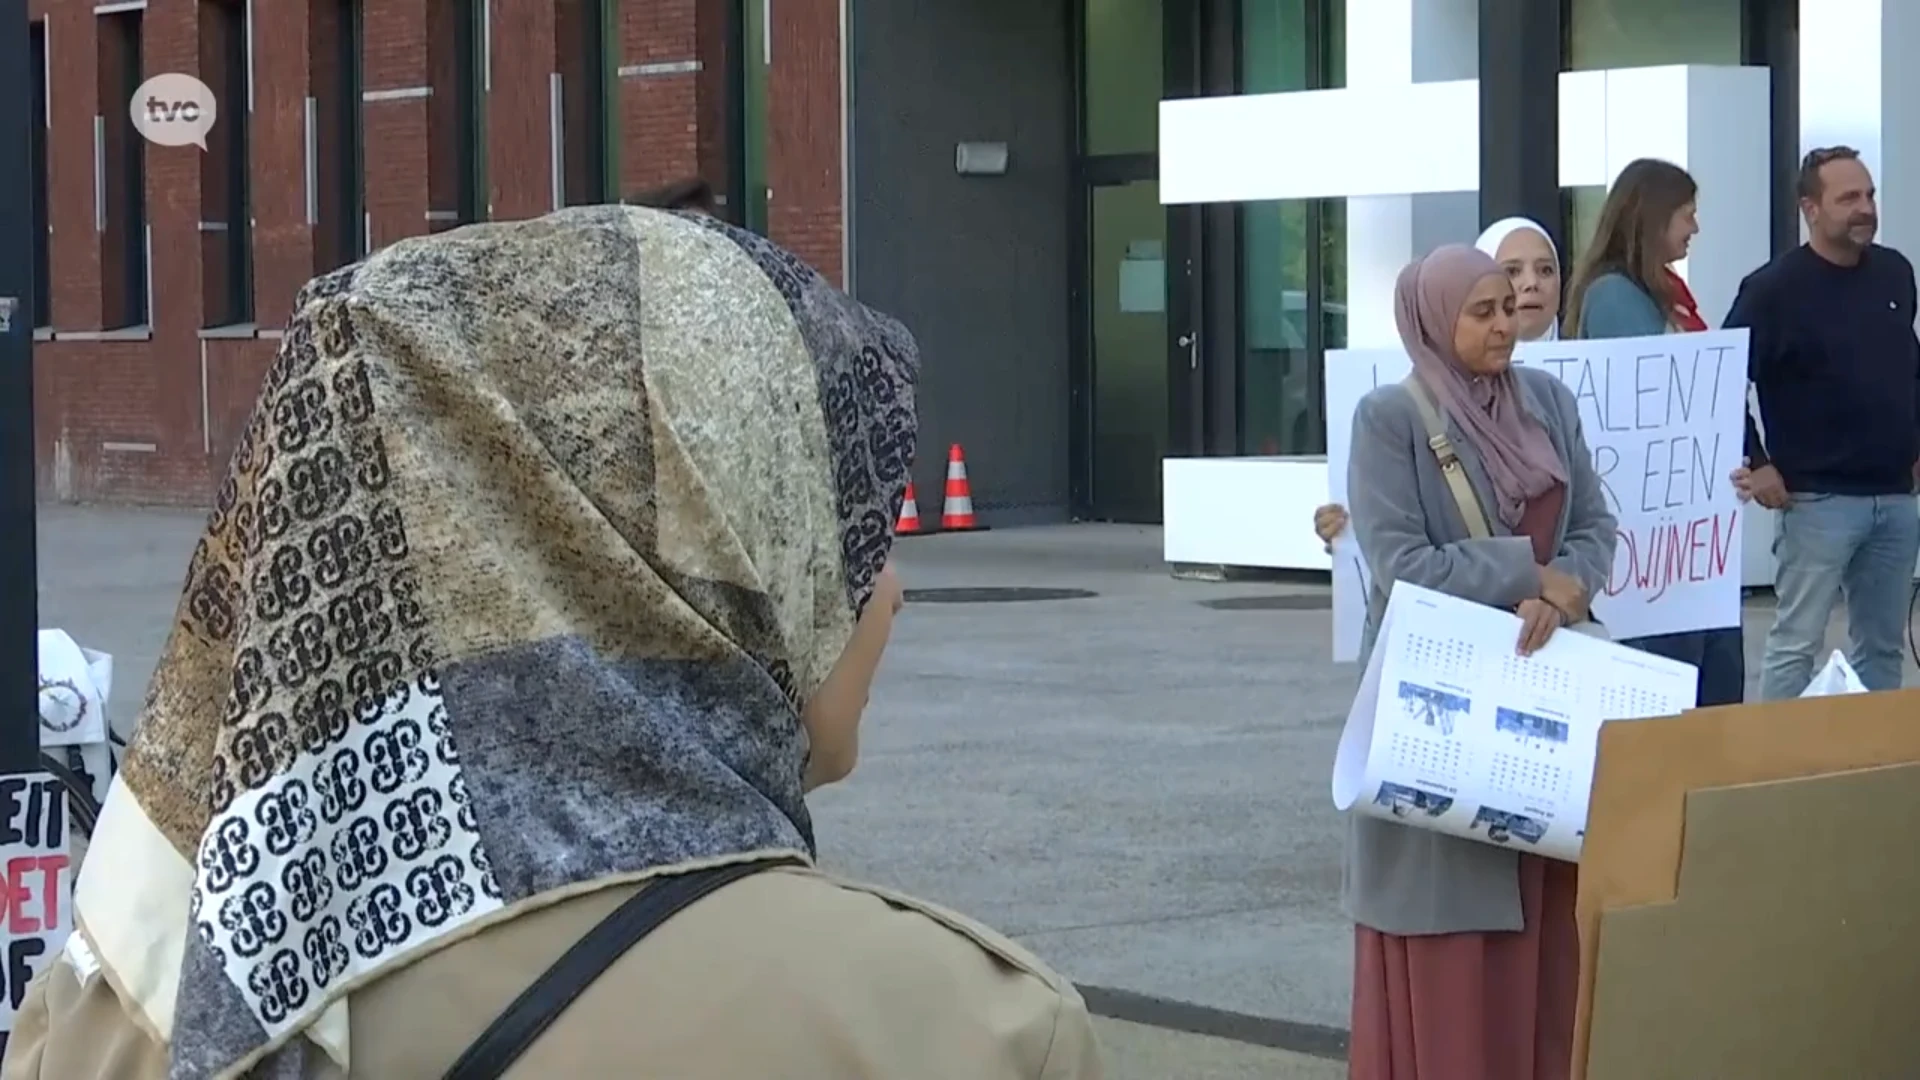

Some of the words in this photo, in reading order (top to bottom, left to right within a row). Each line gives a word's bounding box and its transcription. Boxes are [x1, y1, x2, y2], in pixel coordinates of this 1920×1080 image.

[1543, 346, 1736, 432] TALENT
[1595, 445, 1622, 513] R
[1641, 433, 1720, 513] EEN
[1604, 509, 1737, 604] DWIJNEN
[0, 855, 70, 935] ET
[0, 937, 46, 1011] F
